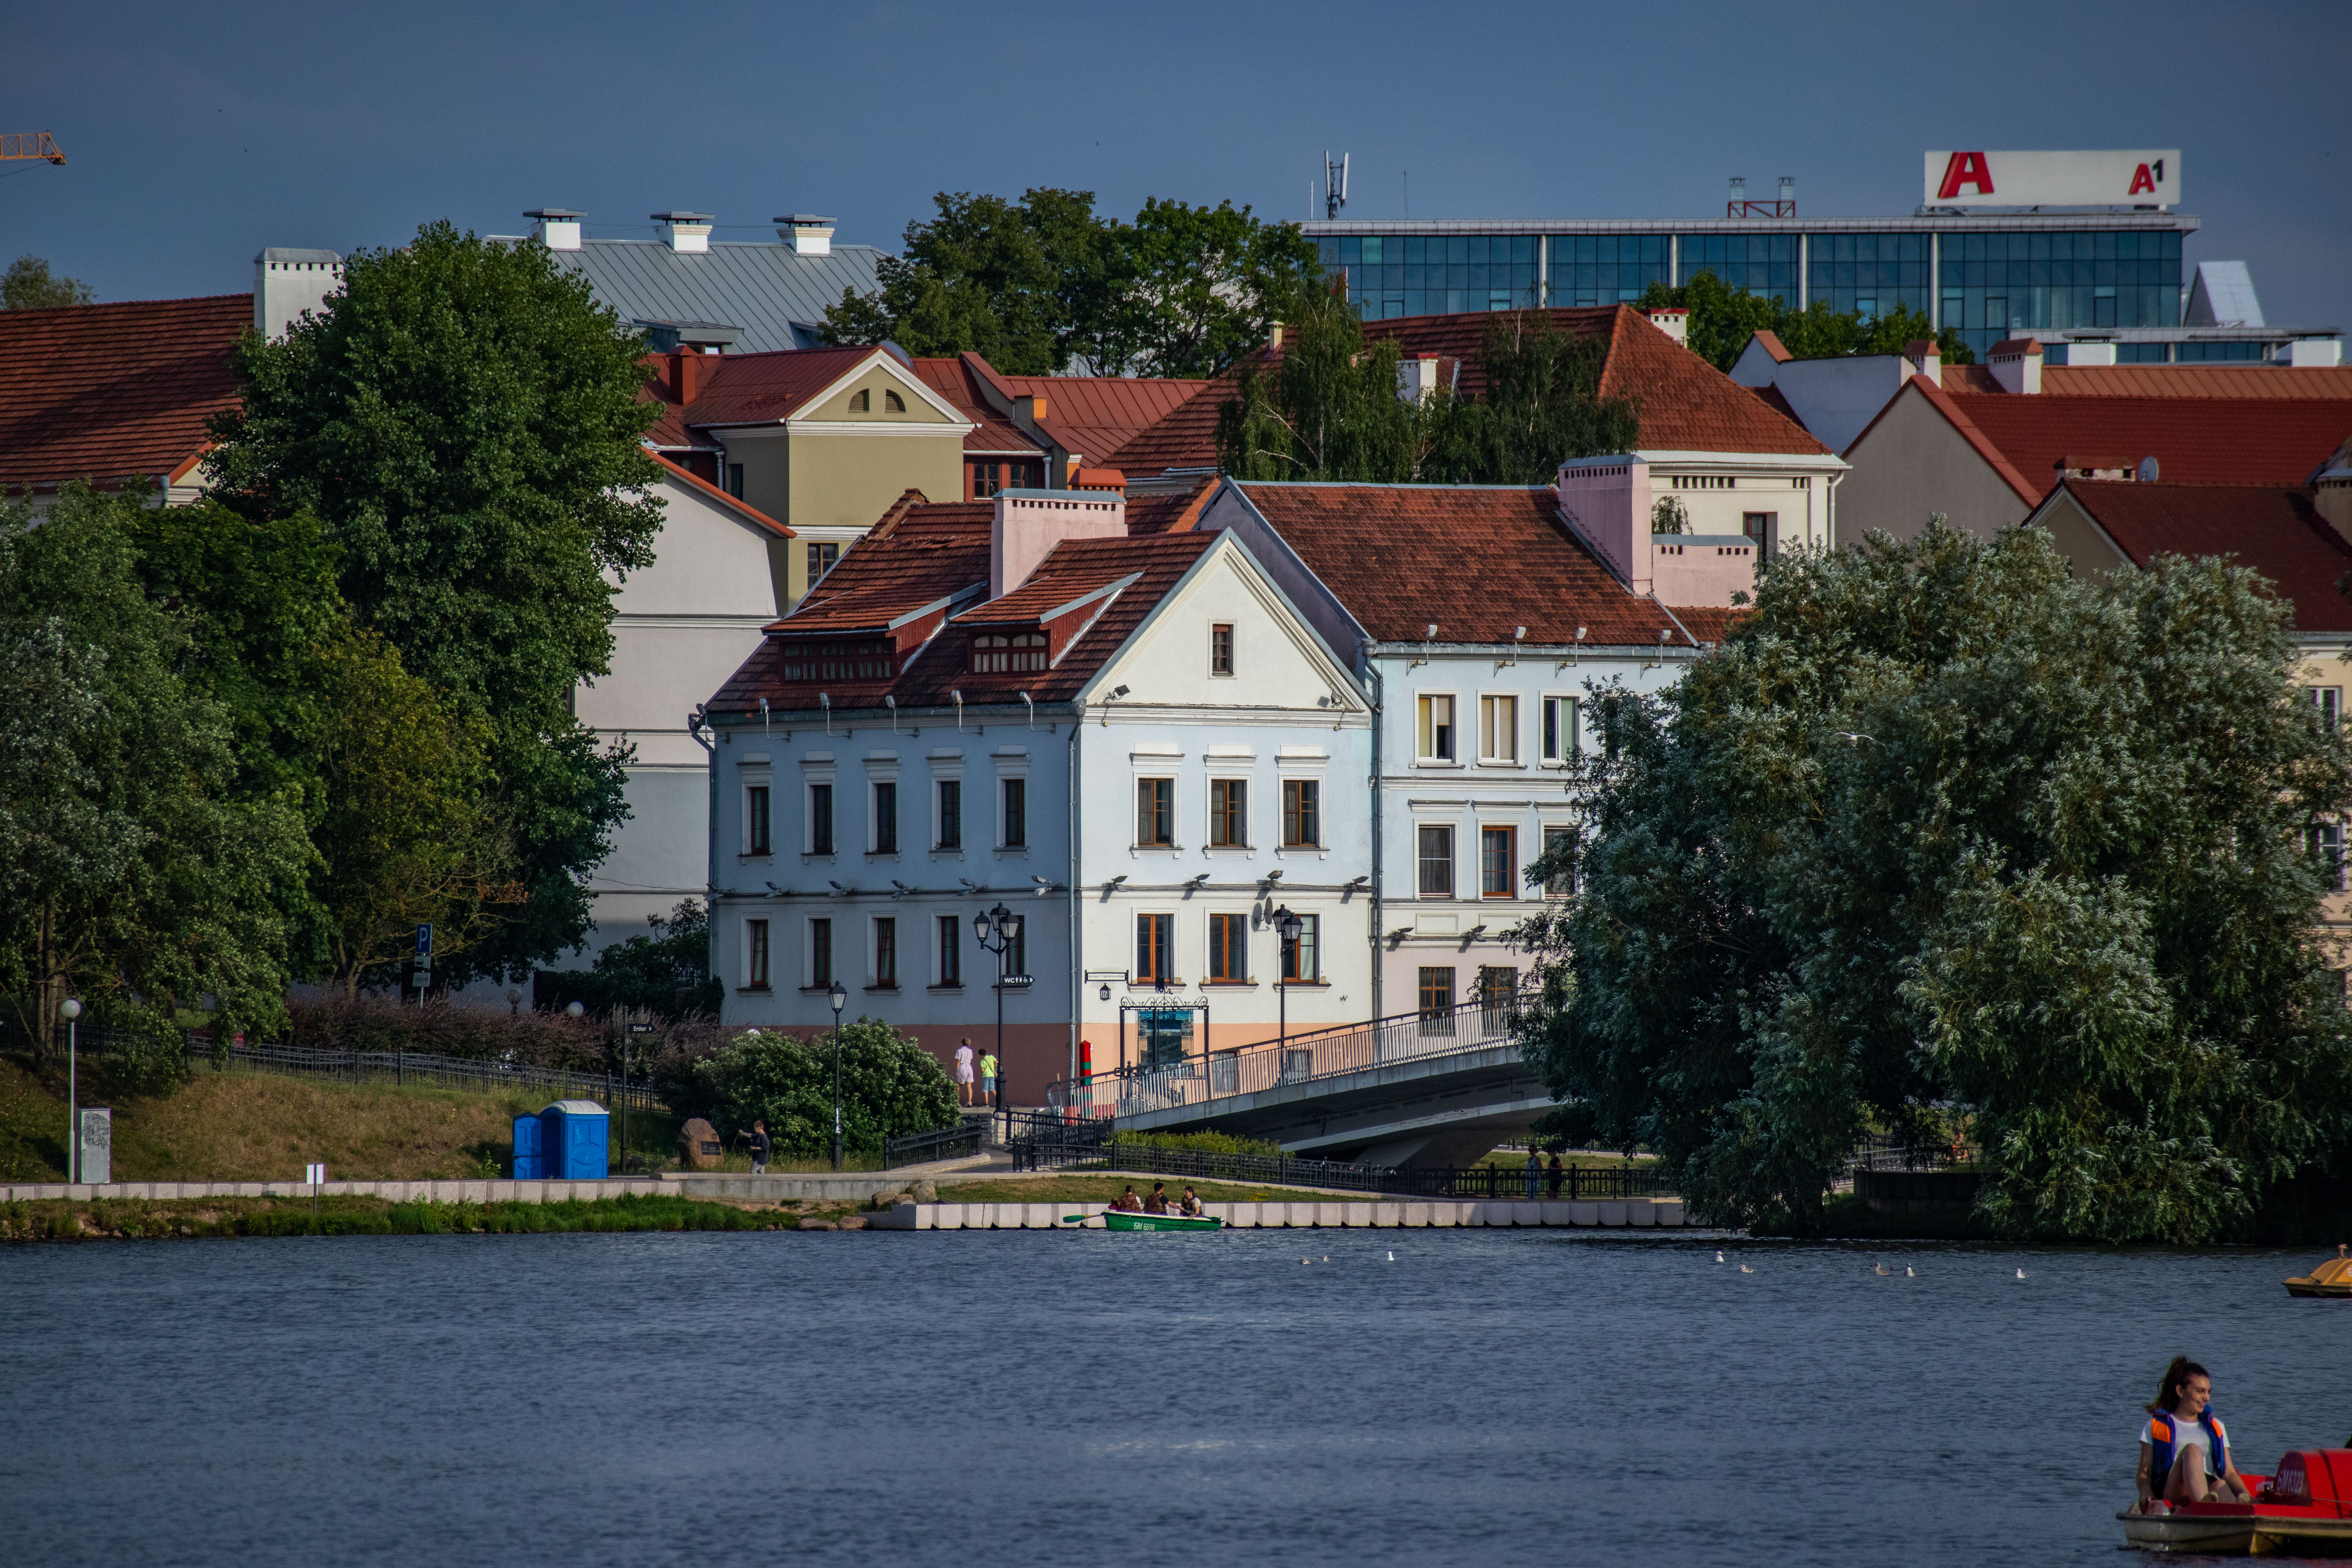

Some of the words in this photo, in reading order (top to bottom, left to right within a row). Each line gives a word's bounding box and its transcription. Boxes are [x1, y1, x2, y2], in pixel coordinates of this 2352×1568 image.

[2128, 159, 2163, 195] A1
[419, 927, 427, 949] P
[1134, 1222, 1143, 1230] БМ
[1143, 1223, 1155, 1231] 6699
